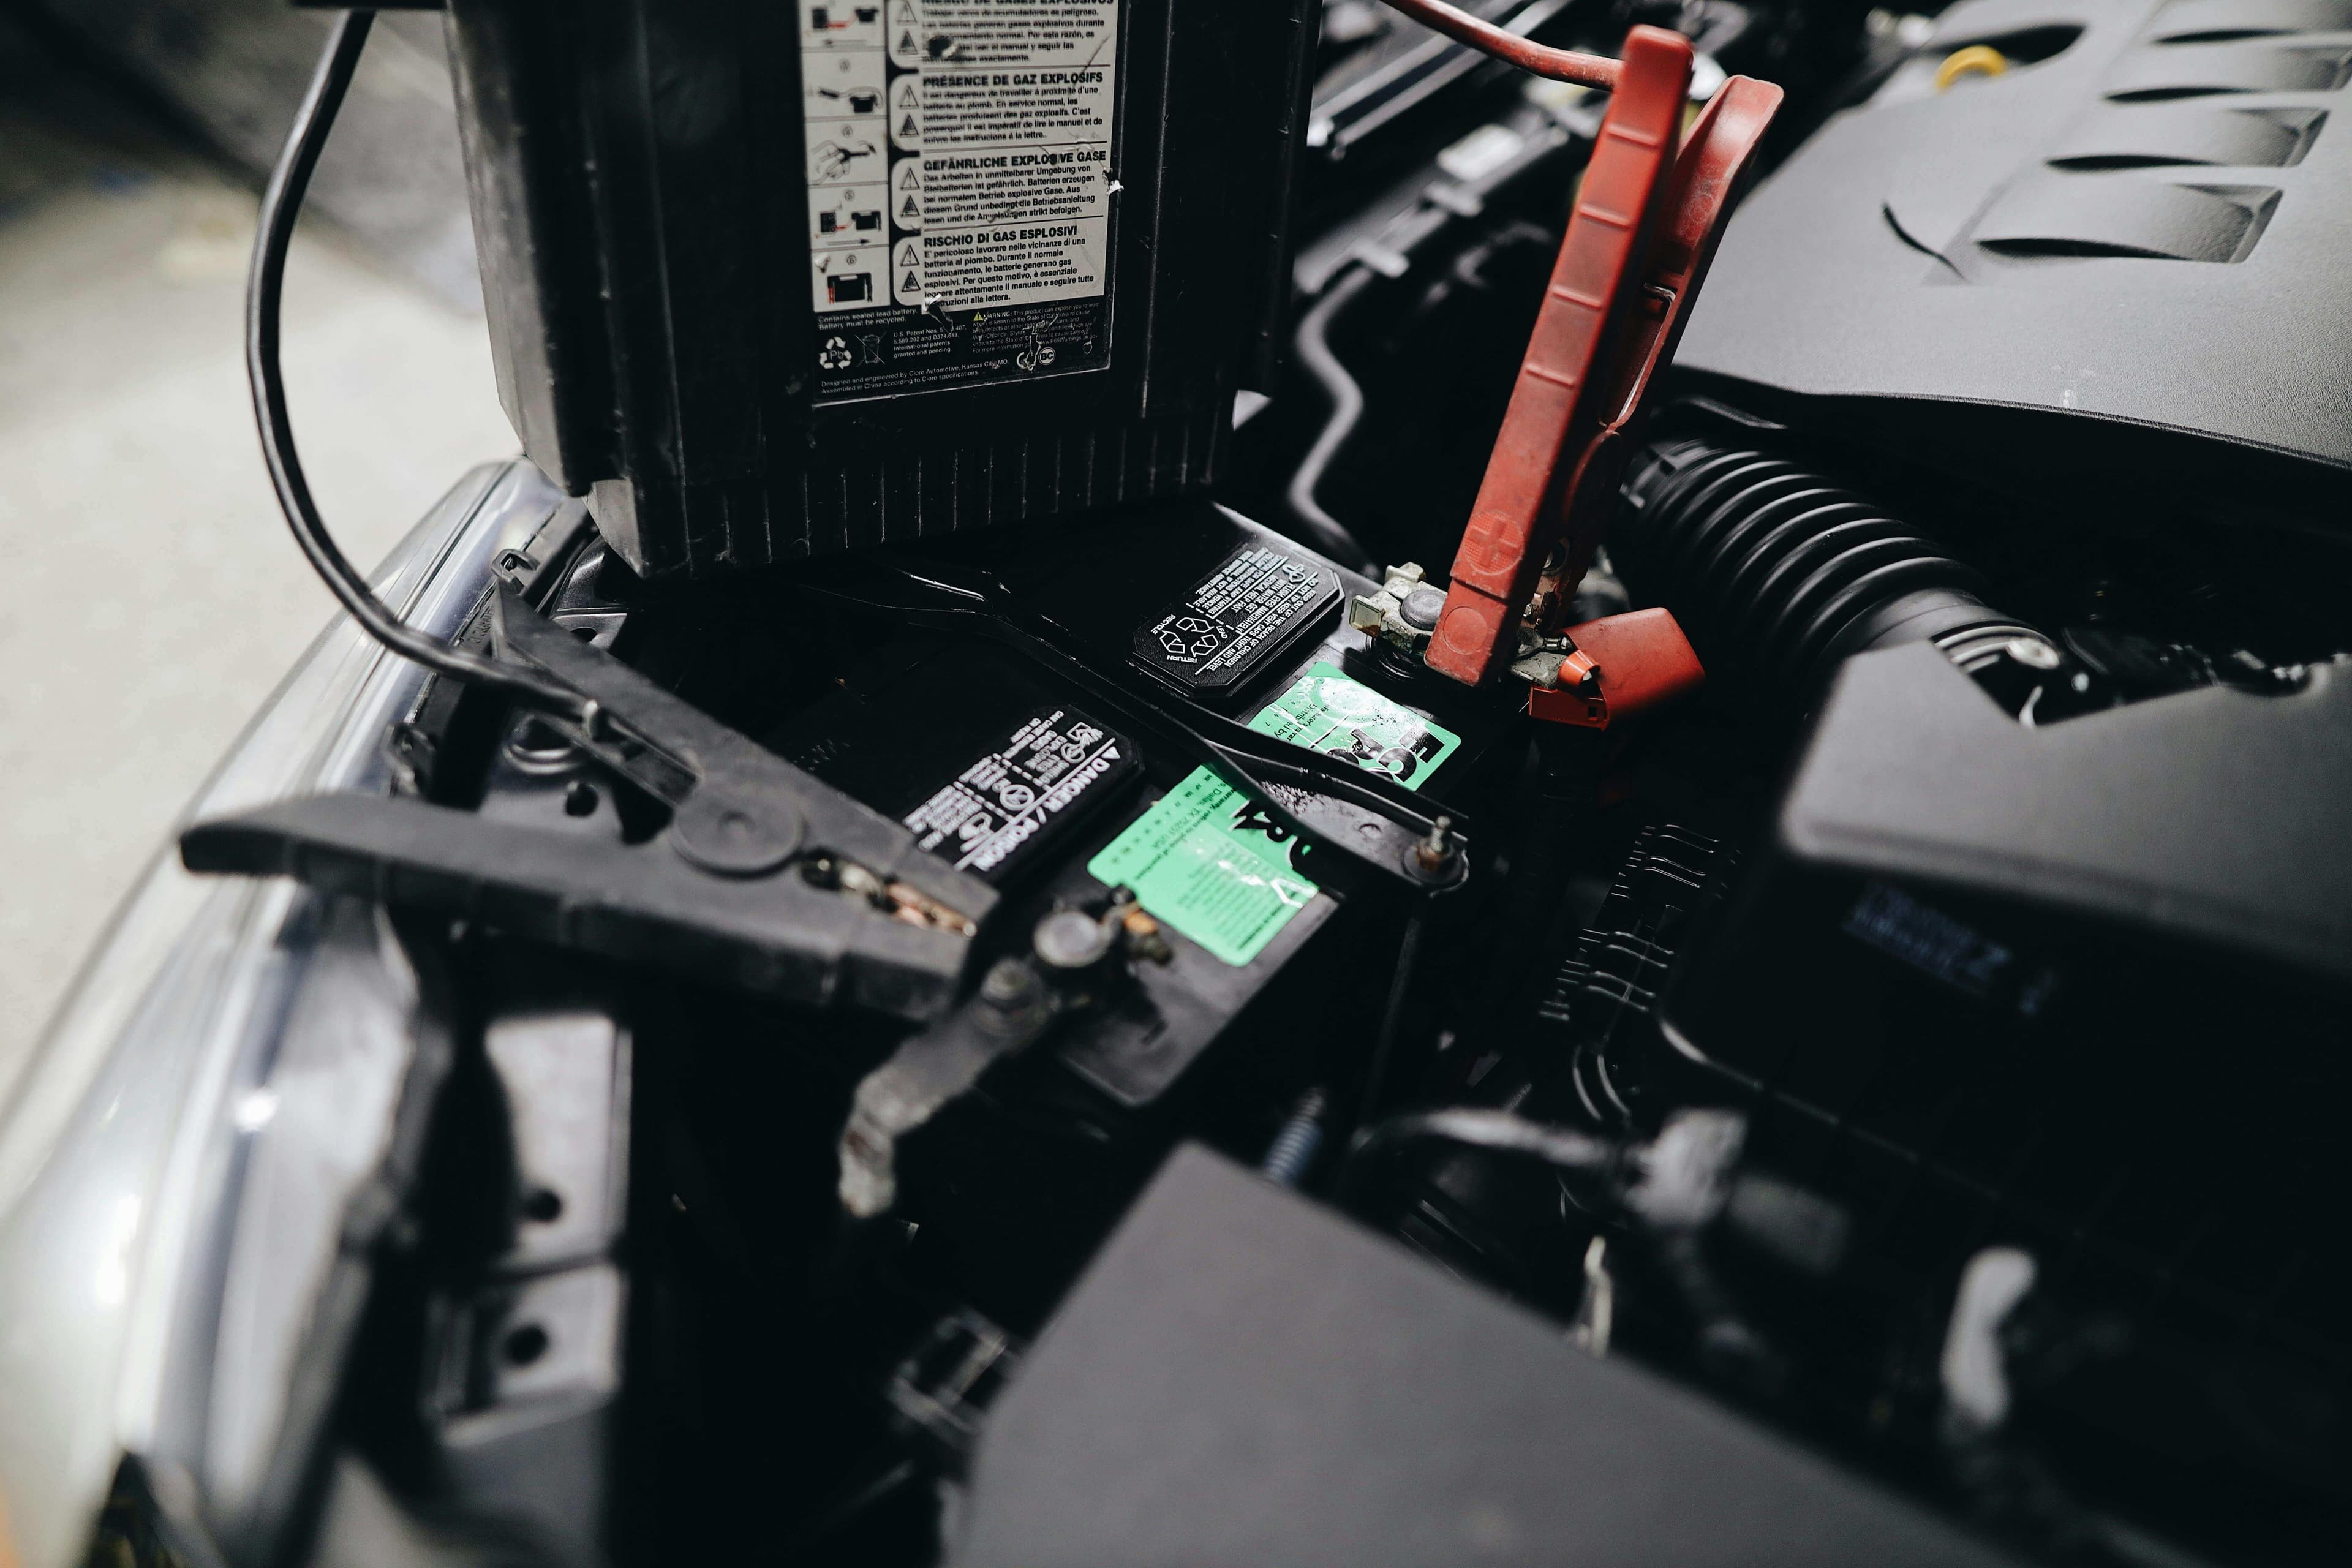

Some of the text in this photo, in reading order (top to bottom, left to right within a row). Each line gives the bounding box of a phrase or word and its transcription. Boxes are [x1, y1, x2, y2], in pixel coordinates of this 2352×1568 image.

[993, 74, 1103, 85] DE GAZ EXPLOSIFS
[1041, 87, 1076, 97] proximité
[1037, 98, 1065, 107] normal,
[1034, 109, 1069, 118] explosifs.
[924, 152, 1106, 170] GEFÄHRLICHE GASE
[984, 168, 1035, 178] unmittelbarer
[1036, 165, 1076, 176] Umgebung
[986, 179, 1025, 190] gefährlich.
[1027, 176, 1060, 186] Batterien
[1061, 176, 1095, 185] erzeugen
[978, 190, 1006, 199] Betrieb
[1007, 188, 1042, 199] explosive
[954, 203, 978, 211] Grund
[980, 200, 1018, 211] unbedingt
[1032, 194, 1095, 208] Betriebsanleitung
[1028, 208, 1047, 216] strikt
[1049, 206, 1082, 216] befolgen.
[924, 226, 1077, 247] RISCHIO DI GAS ESPLOSIVI
[933, 247, 974, 259] pericoloso
[976, 244, 1007, 254] lavorare
[1008, 243, 1026, 251] nelle
[1028, 239, 1062, 249] vicinanze
[924, 258, 954, 268] batteria
[964, 255, 995, 266] piombo.
[997, 252, 1026, 262] Durante
[1033, 249, 1063, 258] normale
[924, 266, 983, 280] funzionamento,
[993, 263, 1022, 272] batterie
[1022, 261, 1057, 271] generano
[924, 277, 960, 290] esplosivi.
[977, 274, 1003, 285] questo
[1005, 271, 1031, 282] motivo,
[1039, 267, 1077, 277] essenziale
[954, 284, 1003, 295] attentamente
[1011, 280, 1042, 290] manuale
[1049, 277, 1076, 288] seguire
[1077, 275, 1094, 284] tutte
[985, 293, 1011, 302] lettera.
[851, 312, 875, 320] sealed
[892, 307, 918, 317] battery.
[818, 322, 844, 331] Battery
[875, 316, 906, 326] recycled.
[829, 349, 844, 360] Pb
[1041, 352, 1054, 361] BC
[1231, 590, 1260, 613] HELP FAST
[1244, 603, 1258, 614] GET
[1264, 595, 1281, 608] EYES
[1150, 614, 1176, 635] RECYCLE
[1224, 589, 1318, 668] KEEP OUT OF THE REACH OF CHILDREN
[1206, 601, 1292, 671] KEEP VENT CAPS TIGHT AND LEVEL
[1215, 625, 1228, 639] LEAD
[1166, 654, 1197, 664] RETURN
[1049, 710, 1064, 722] CAN
[1273, 728, 1286, 739] by
[1023, 734, 1068, 769] EXPLOSIVE
[1042, 758, 1110, 812] DANGER
[1196, 786, 1223, 809] Dallas,
[970, 815, 1039, 870] POISON
